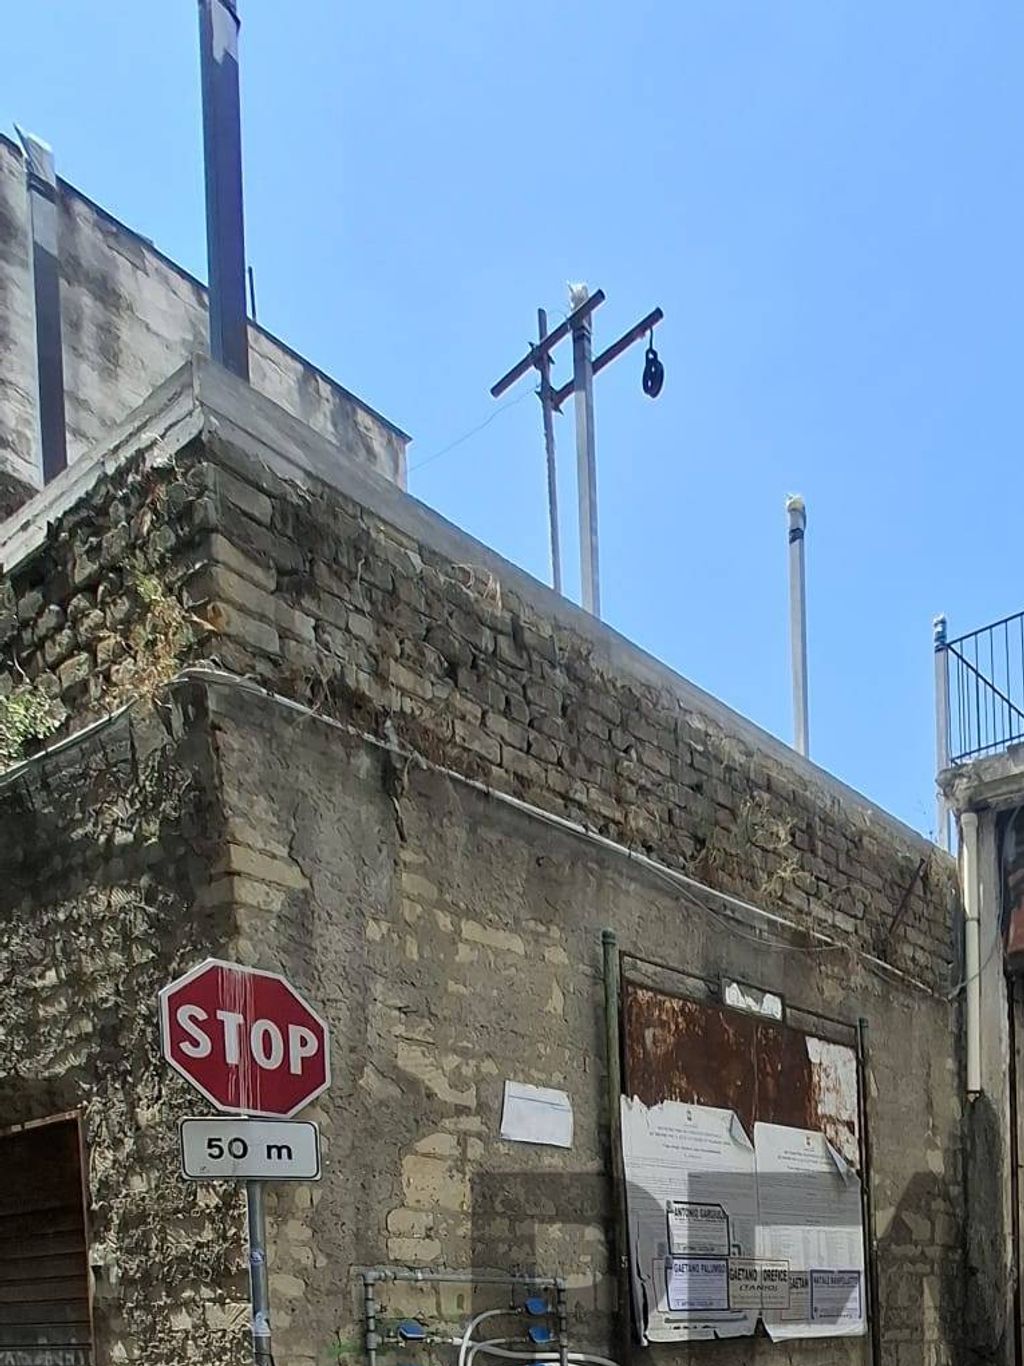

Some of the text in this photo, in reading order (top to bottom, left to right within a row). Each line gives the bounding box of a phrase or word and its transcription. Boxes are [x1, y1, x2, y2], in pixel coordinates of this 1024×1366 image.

[176, 1004, 319, 1075] STOP
[206, 1137, 293, 1160] 50 m
[729, 1268, 758, 1281] GAETANO
